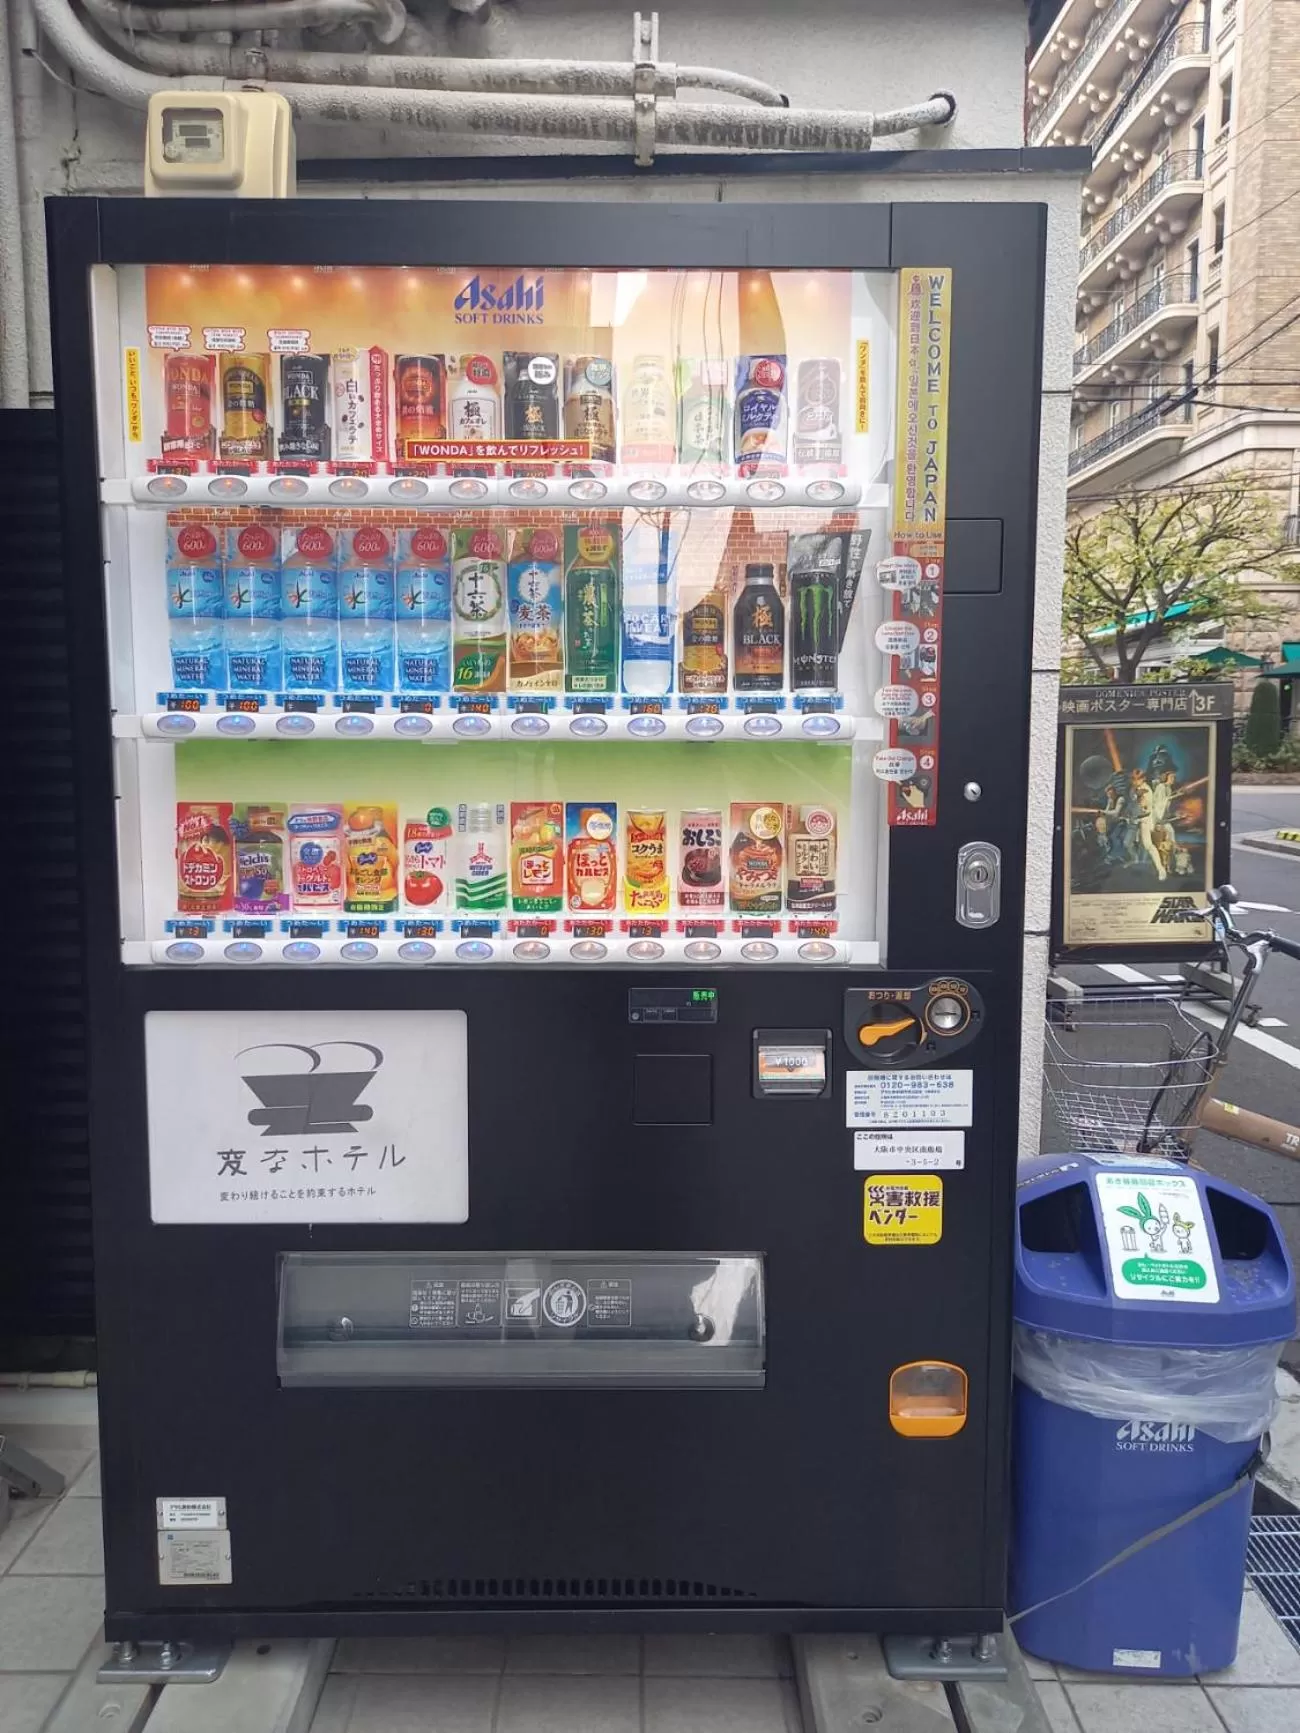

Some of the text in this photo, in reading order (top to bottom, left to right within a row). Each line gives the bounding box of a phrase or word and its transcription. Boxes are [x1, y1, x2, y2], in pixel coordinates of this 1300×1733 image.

[454, 275, 545, 310] Asahi
[455, 312, 544, 324] SOFT DRINKS
[922, 275, 945, 522] WELCOME TO JAPAN
[346, 379, 358, 445] 白いカフェラテ
[467, 572, 488, 618] 十六茶
[518, 606, 552, 621] 麦茶
[743, 634, 781, 645] BLACK
[1061, 695, 1216, 713] 映画ポスター専門店 3F
[897, 810, 928, 822] Asahi
[420, 855, 446, 869] トマト
[576, 852, 609, 867] ほっと
[184, 862, 218, 873] ドデカミン
[523, 869, 551, 879] レモン
[575, 867, 609, 877] カルピス
[184, 874, 217, 886] ストロング
[1159, 896, 1198, 909] STAR
[216, 1144, 407, 1177] 変なホテル
[219, 1186, 377, 1202] 変わり続けることを約束するホテル
[868, 1185, 940, 1207] 災害救援
[869, 1208, 919, 1225] ベンダー
[1116, 1441, 1194, 1452] SOFT DRINKS
